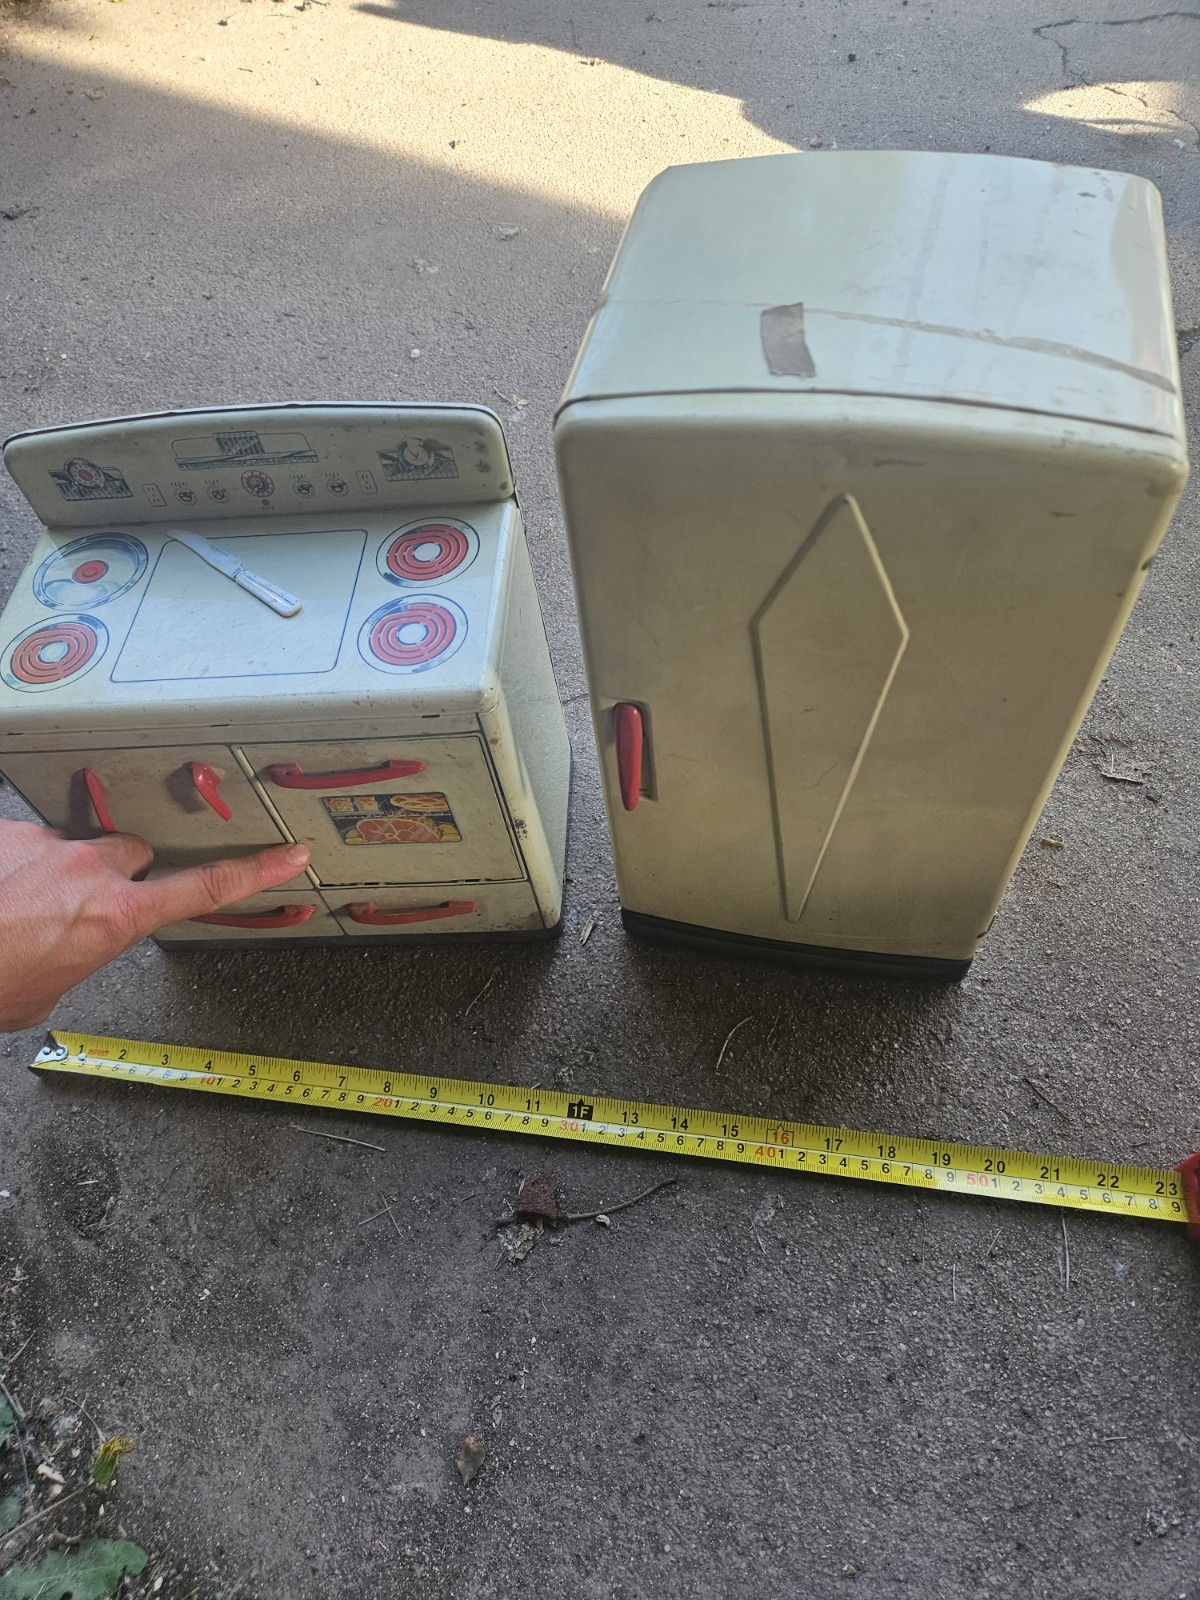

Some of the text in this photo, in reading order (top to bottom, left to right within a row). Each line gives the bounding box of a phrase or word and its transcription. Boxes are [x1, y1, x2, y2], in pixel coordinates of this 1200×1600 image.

[79, 1044, 84, 1053] 1
[118, 1049, 127, 1060] 2
[161, 1054, 169, 1066] 3
[204, 1060, 212, 1071] 4
[248, 1065, 257, 1076] 5
[293, 1071, 301, 1082] 6
[338, 1076, 347, 1087] 7
[383, 1081, 391, 1093] 8
[430, 1087, 437, 1098] 9
[478, 1093, 495, 1106] 10
[525, 1099, 540, 1112] 11
[572, 1106, 590, 1119] 1F
[622, 1111, 639, 1124] 13
[671, 1117, 689, 1131] 14
[721, 1124, 739, 1137] 15
[772, 1131, 789, 1144] 16
[824, 1138, 843, 1151] 17
[877, 1144, 896, 1159] 18
[932, 1152, 950, 1166] 19
[984, 1159, 1005, 1173] 20
[1040, 1166, 1059, 1181] 21
[1097, 1173, 1119, 1189] 22
[1155, 1181, 1177, 1196] 23
[95, 1061, 103, 1070] 4
[112, 1063, 120, 1072] 5
[128, 1065, 138, 1075] 6
[146, 1068, 155, 1076] 7
[162, 1070, 172, 1079] 8
[179, 1072, 189, 1082] 9
[200, 1076, 216, 1085] 10
[216, 1077, 223, 1086] 1
[231, 1079, 241, 1088] 2
[249, 1081, 258, 1091] 3
[266, 1083, 275, 1093] 4
[285, 1086, 293, 1095] 5
[302, 1088, 311, 1098] 6
[321, 1090, 330, 1099] 7
[338, 1092, 347, 1102] 8
[356, 1094, 365, 1104] 9
[372, 1096, 393, 1108] 20
[393, 1099, 400, 1108] 1
[411, 1101, 420, 1111] 2
[429, 1103, 437, 1113] 3
[447, 1106, 456, 1115] 4
[466, 1108, 474, 1118] 5
[484, 1110, 493, 1120] 6
[503, 1112, 512, 1123] 7
[522, 1115, 530, 1125] 8
[541, 1117, 549, 1128] 9
[560, 1119, 579, 1132] 30
[581, 1122, 587, 1133] 1
[598, 1125, 607, 1135] 2
[618, 1127, 626, 1137] 3
[637, 1131, 645, 1140] 4
[657, 1132, 665, 1143] 5
[676, 1135, 684, 1145] 6
[696, 1137, 705, 1148] 7
[716, 1140, 725, 1151] 8
[737, 1143, 745, 1153] 9
[755, 1145, 776, 1158] 40
[778, 1148, 784, 1159] 1
[798, 1151, 806, 1162] 2
[818, 1154, 827, 1165] 3
[839, 1157, 847, 1168] 4
[861, 1160, 869, 1170] 5
[882, 1163, 890, 1174] 6
[903, 1166, 911, 1176] 7
[925, 1168, 933, 1179] 8
[946, 1171, 955, 1182] 9
[967, 1173, 989, 1187] 50
[991, 1178, 998, 1188] 1
[1012, 1181, 1021, 1191] 2
[1034, 1183, 1043, 1194] 3
[1057, 1187, 1065, 1197] 4
[1080, 1189, 1088, 1200] 5
[1102, 1193, 1111, 1203] 6
[1124, 1195, 1133, 1206] 7
[1149, 1199, 1157, 1210] 8
[1171, 1202, 1181, 1212] 9
